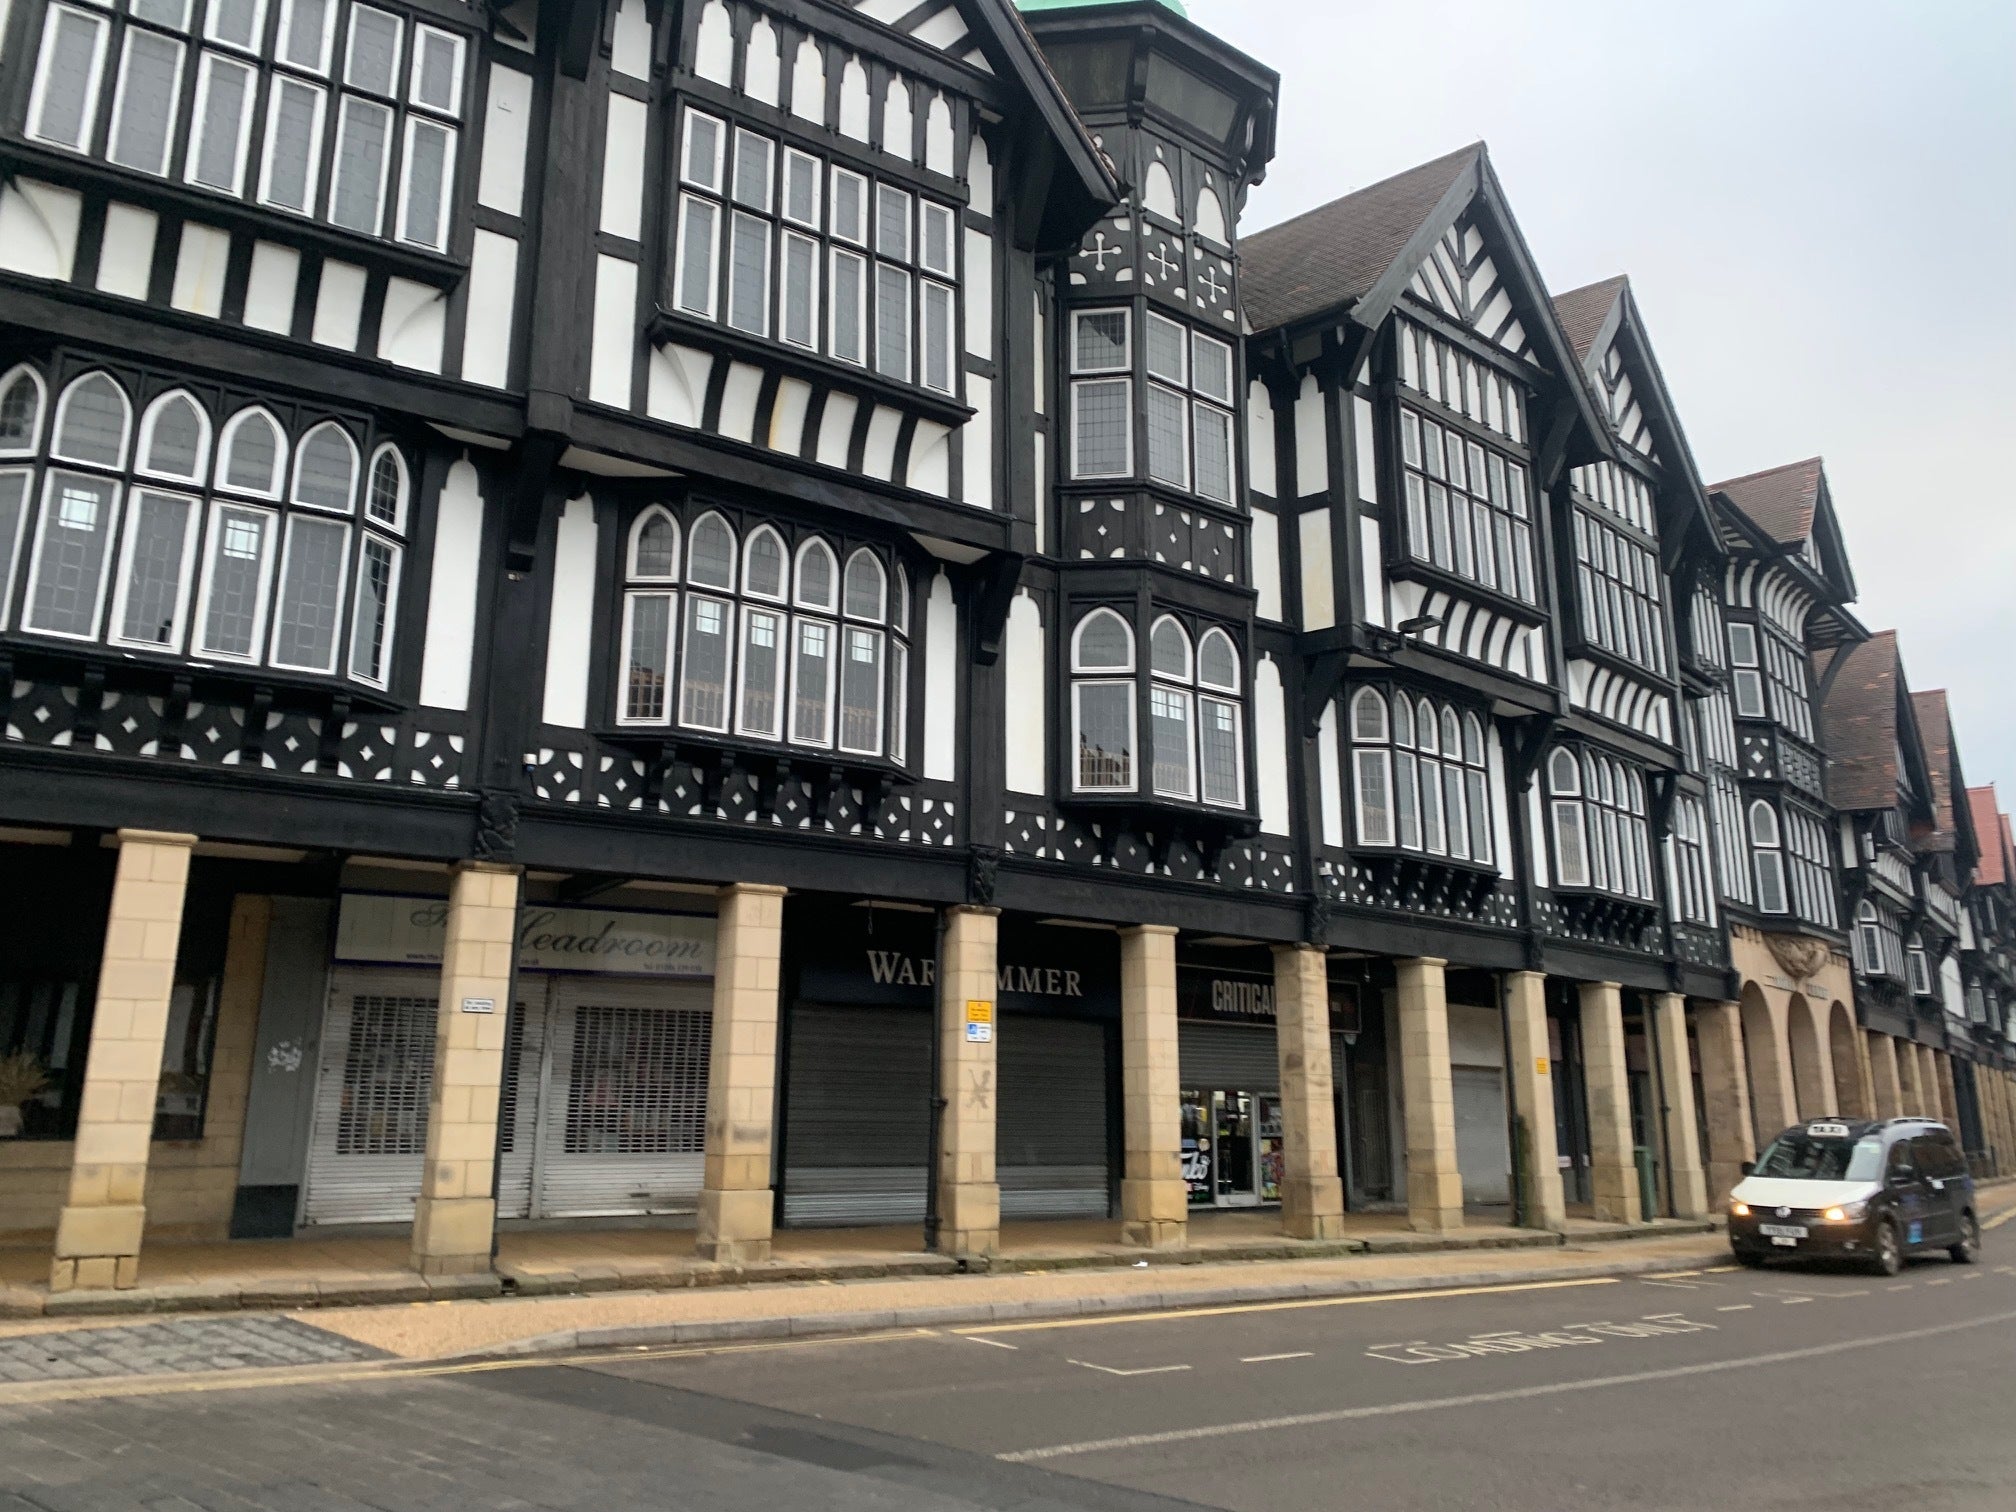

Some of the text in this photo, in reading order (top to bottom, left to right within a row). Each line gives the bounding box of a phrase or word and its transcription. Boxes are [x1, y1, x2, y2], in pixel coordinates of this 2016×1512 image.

[867, 950, 1083, 997] WARMMER
[1813, 1125, 1842, 1134] TAXI
[1363, 1314, 1718, 1364] LOADING ONLY
